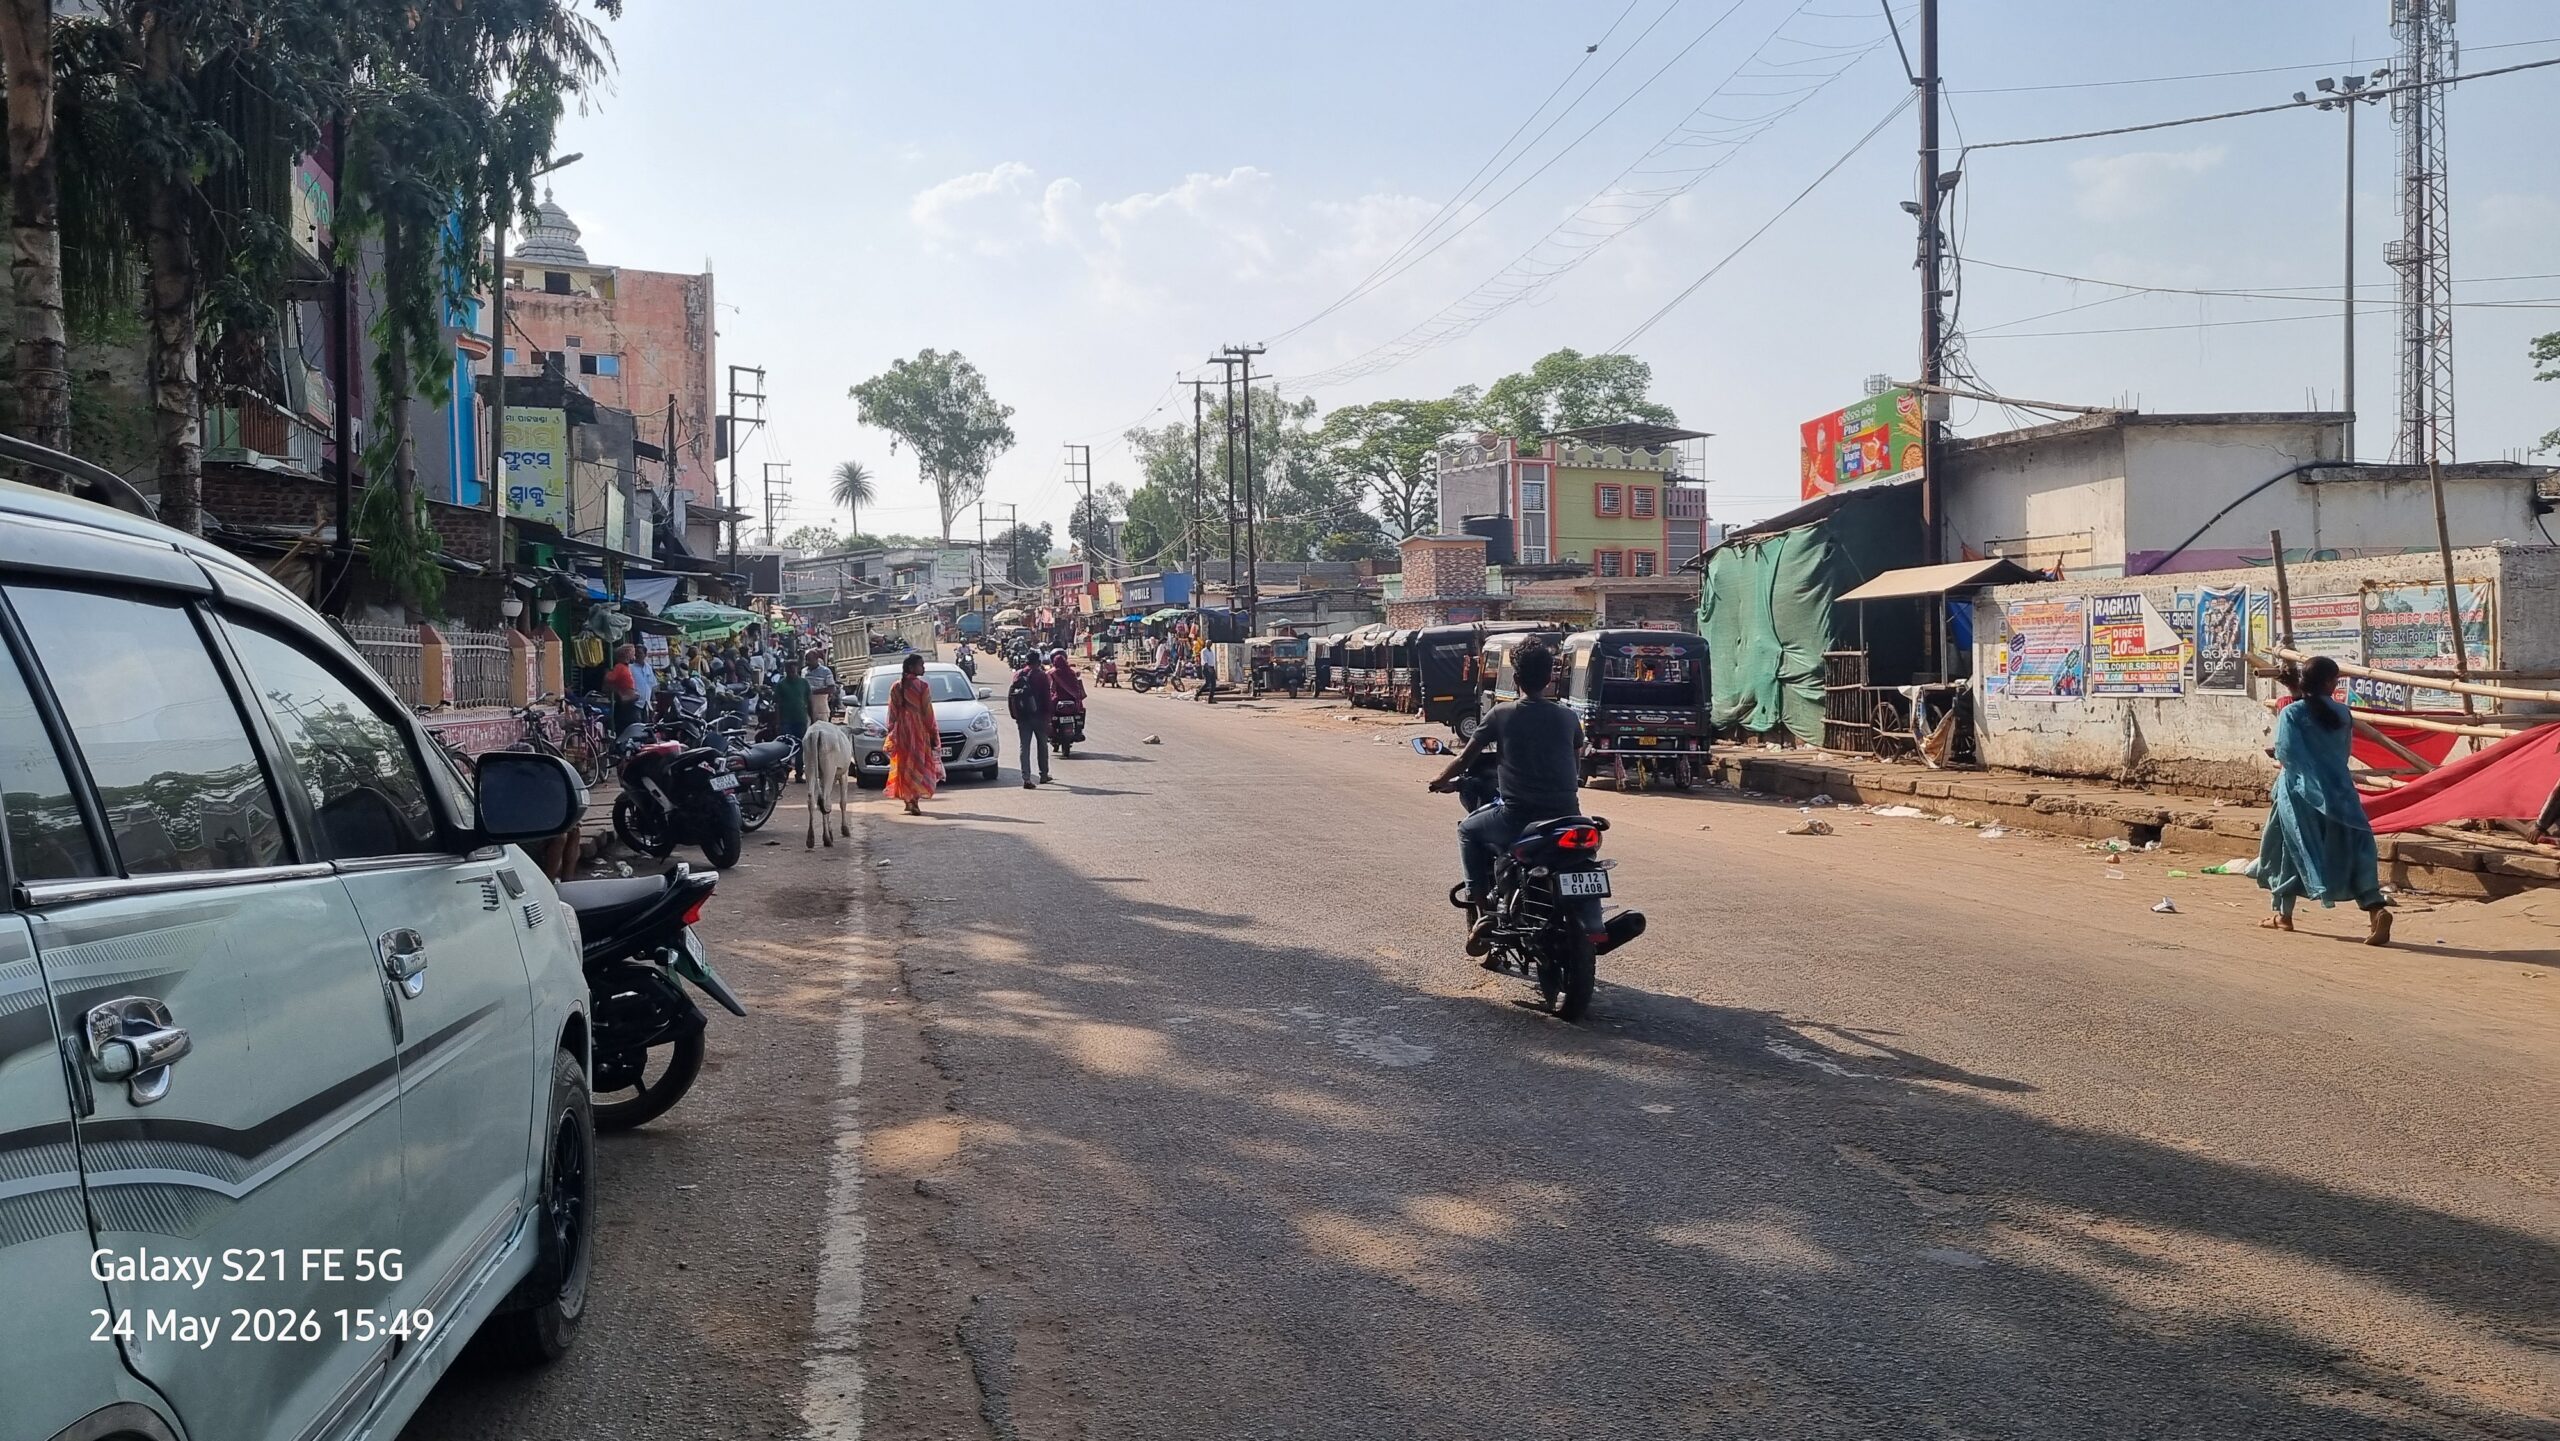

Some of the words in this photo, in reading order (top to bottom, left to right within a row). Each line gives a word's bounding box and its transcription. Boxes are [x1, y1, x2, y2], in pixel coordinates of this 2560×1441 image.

[1130, 587, 1150, 601] MOBILE
[2095, 597, 2143, 617] RAGHAV
[2112, 627, 2144, 639] DIRECT
[2373, 630, 2405, 646] Speak
[2406, 628, 2424, 642] For
[2128, 645, 2144, 654] Class
[2128, 662, 2146, 671] B.SC
[2146, 661, 2160, 671] BBA
[2162, 660, 2178, 670] BCA
[1588, 873, 1599, 883] 12
[1571, 884, 1602, 893] G1408
[96, 1014, 119, 1030] TOYOTA
